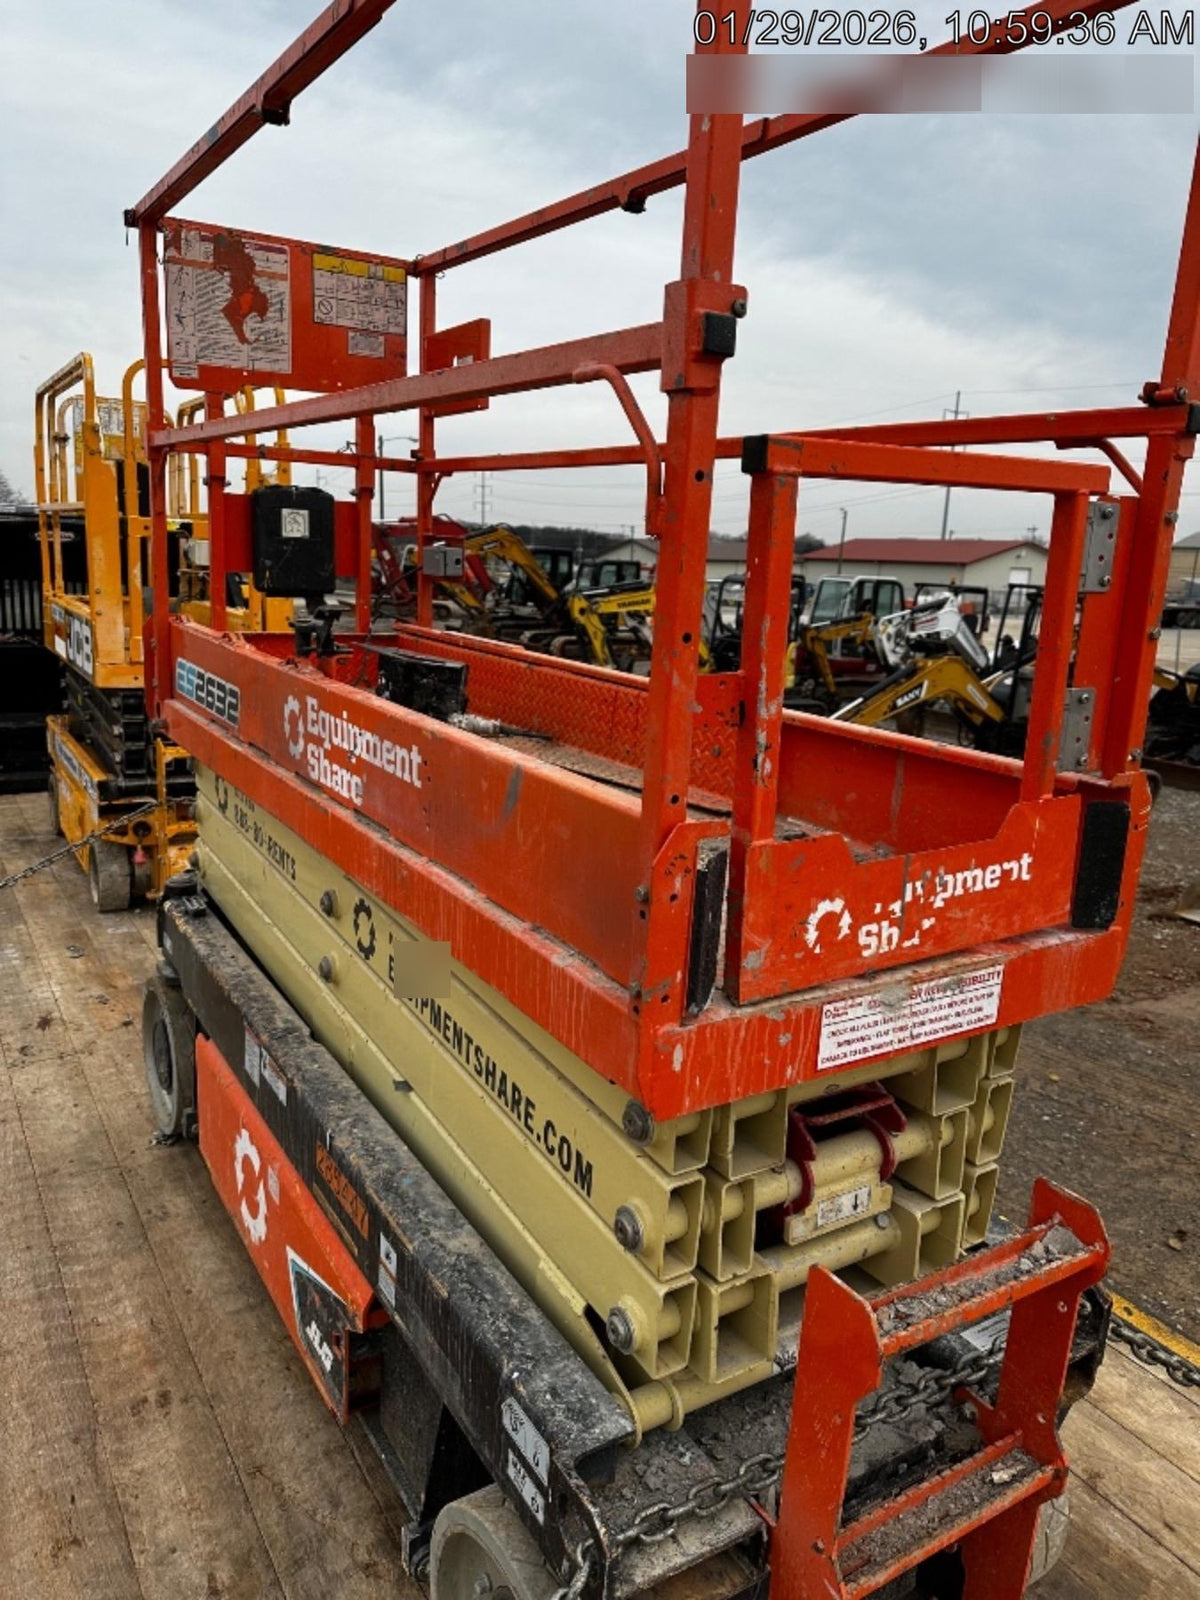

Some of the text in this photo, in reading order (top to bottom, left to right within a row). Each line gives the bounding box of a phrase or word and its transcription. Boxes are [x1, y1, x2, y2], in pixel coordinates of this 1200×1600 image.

[177, 659, 240, 726] ES2632
[306, 695, 422, 790] Equipment
[306, 742, 363, 807] Share
